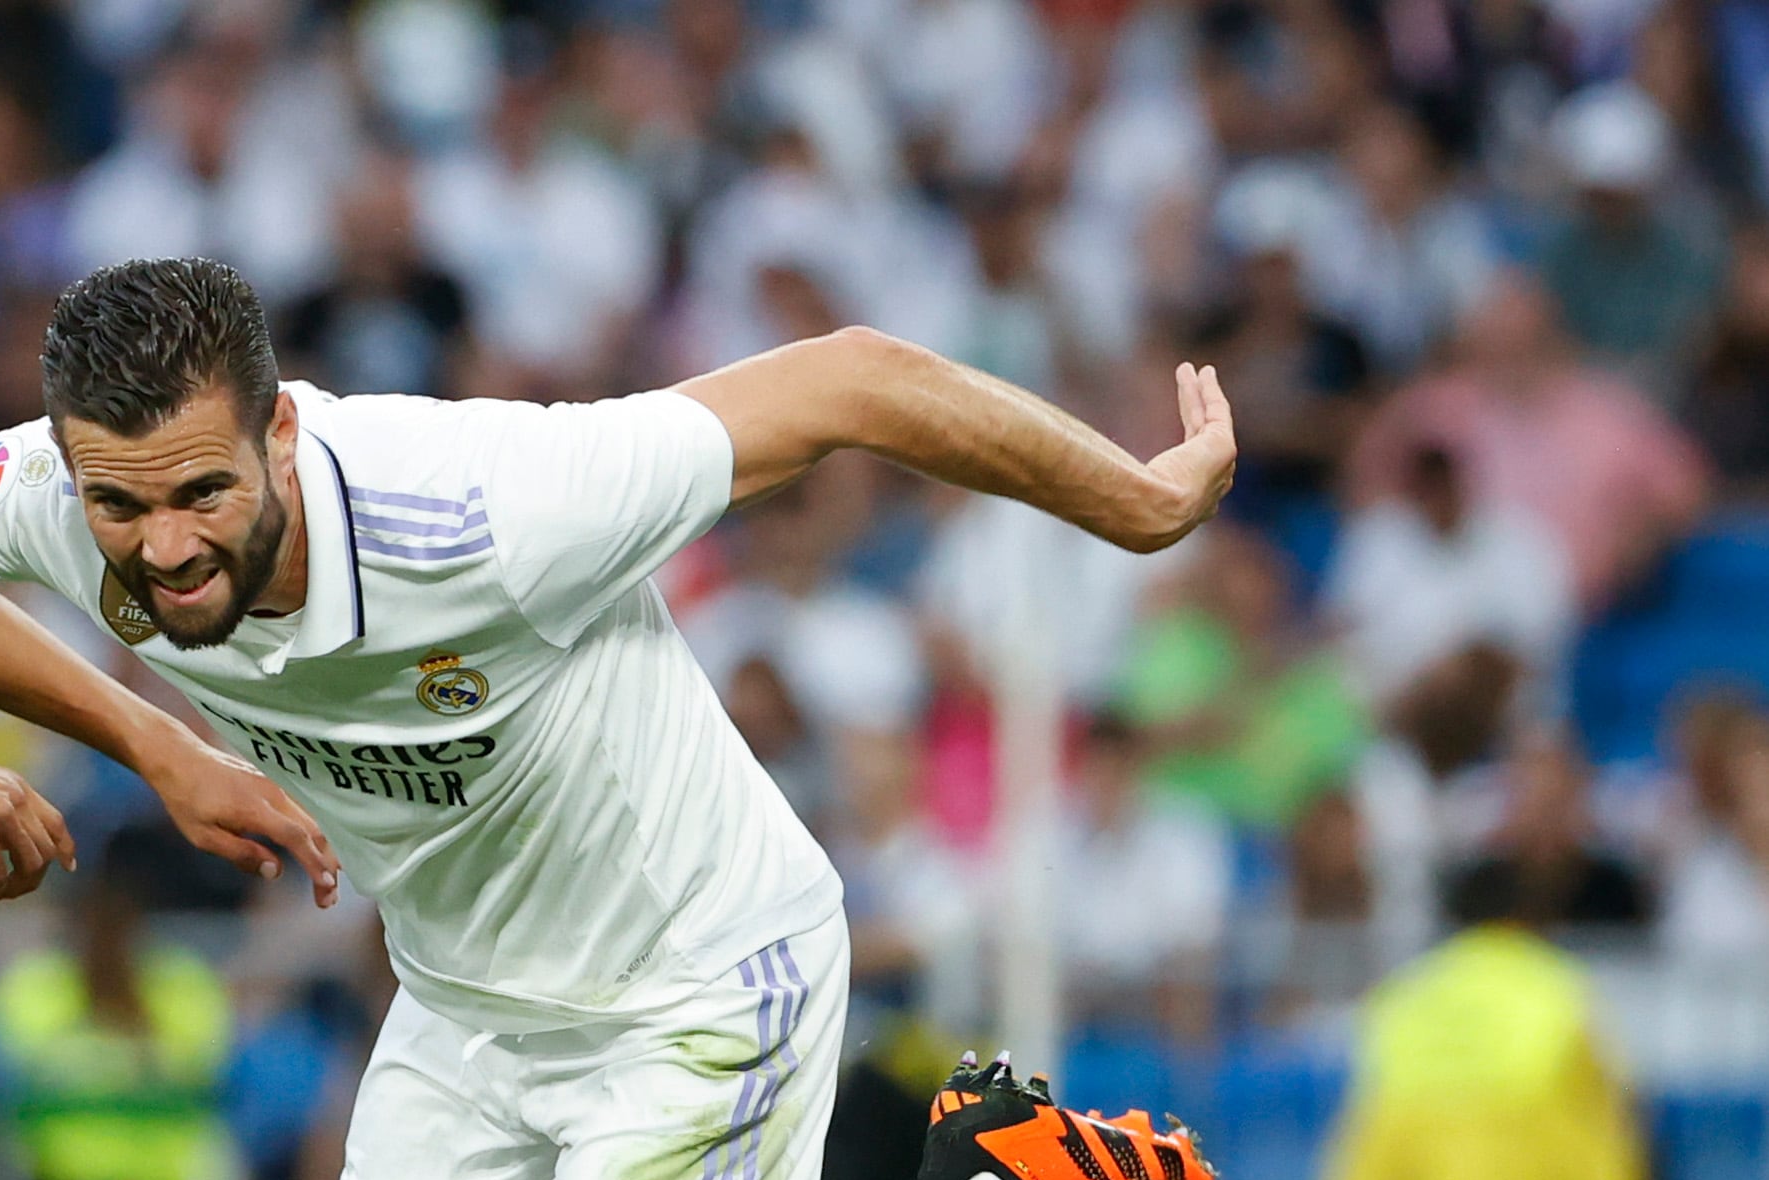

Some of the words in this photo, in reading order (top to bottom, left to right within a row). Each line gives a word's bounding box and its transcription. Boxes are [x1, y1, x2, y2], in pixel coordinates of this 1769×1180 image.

[118, 605, 152, 623] FIFA
[250, 737, 311, 781] FLY
[323, 760, 469, 808] BETTER
